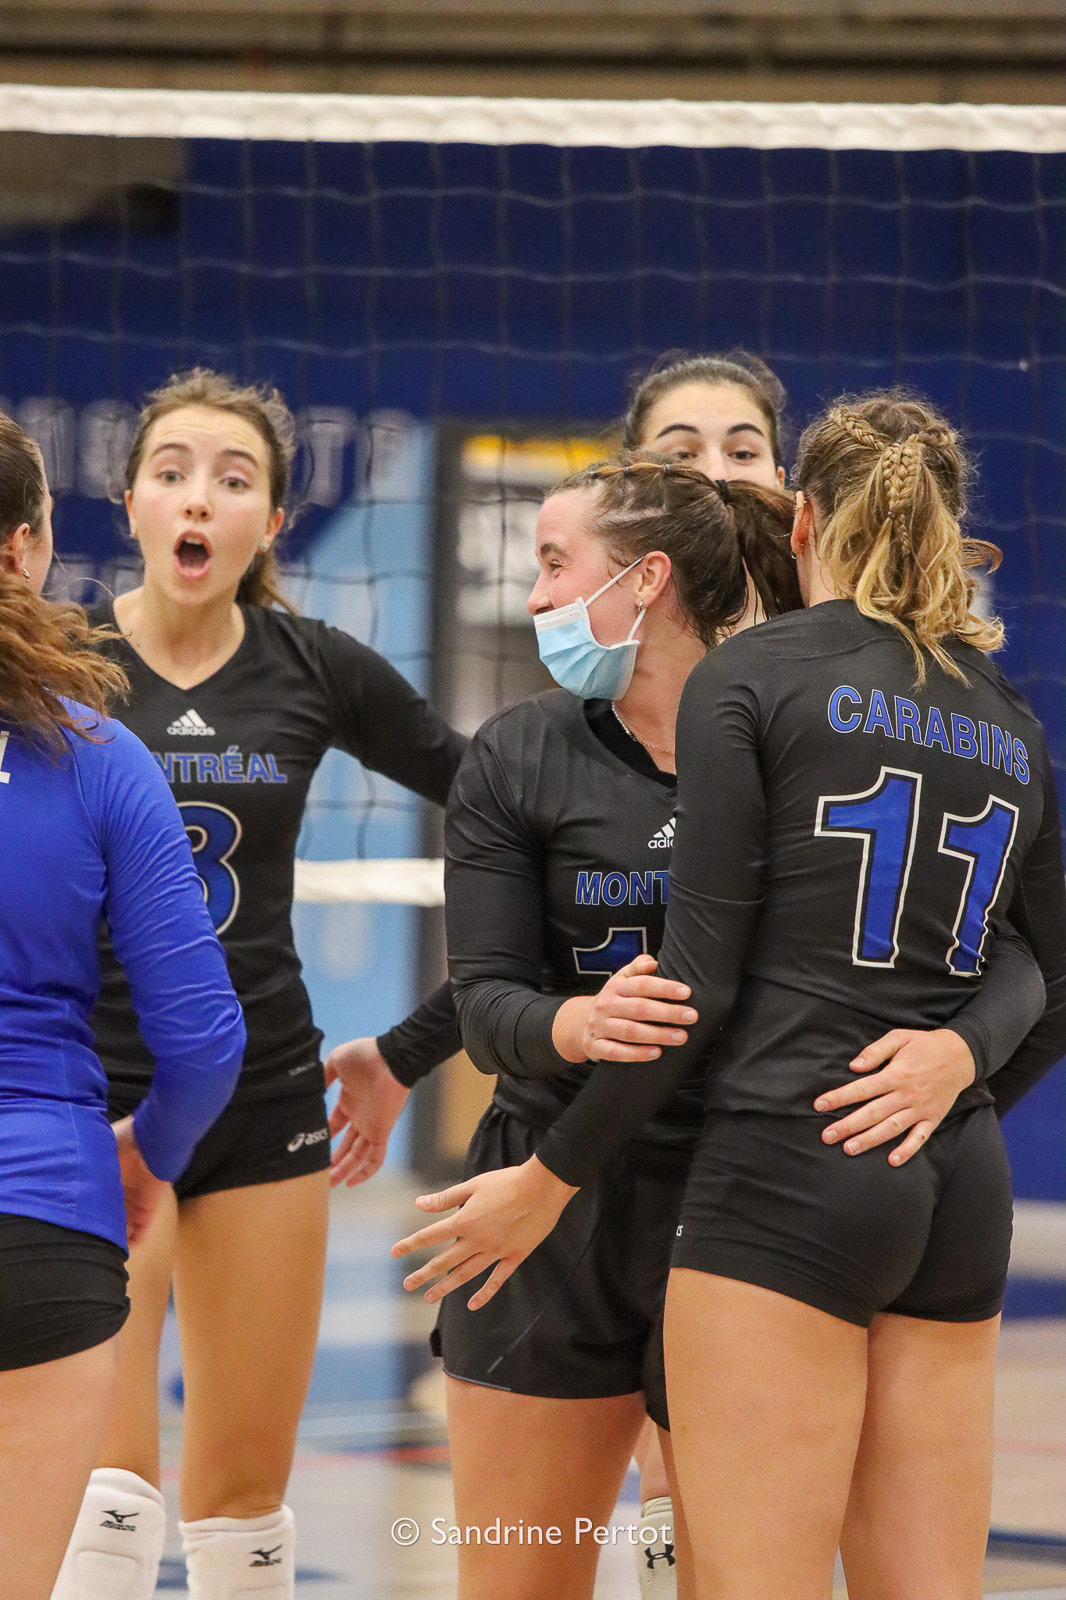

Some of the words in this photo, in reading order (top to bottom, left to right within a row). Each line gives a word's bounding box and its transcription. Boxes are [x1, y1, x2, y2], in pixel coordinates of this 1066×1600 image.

[166, 725, 216, 736] adidas
[827, 684, 1030, 785] CARABINS
[647, 837, 674, 849] adi
[813, 765, 1020, 977] 11
